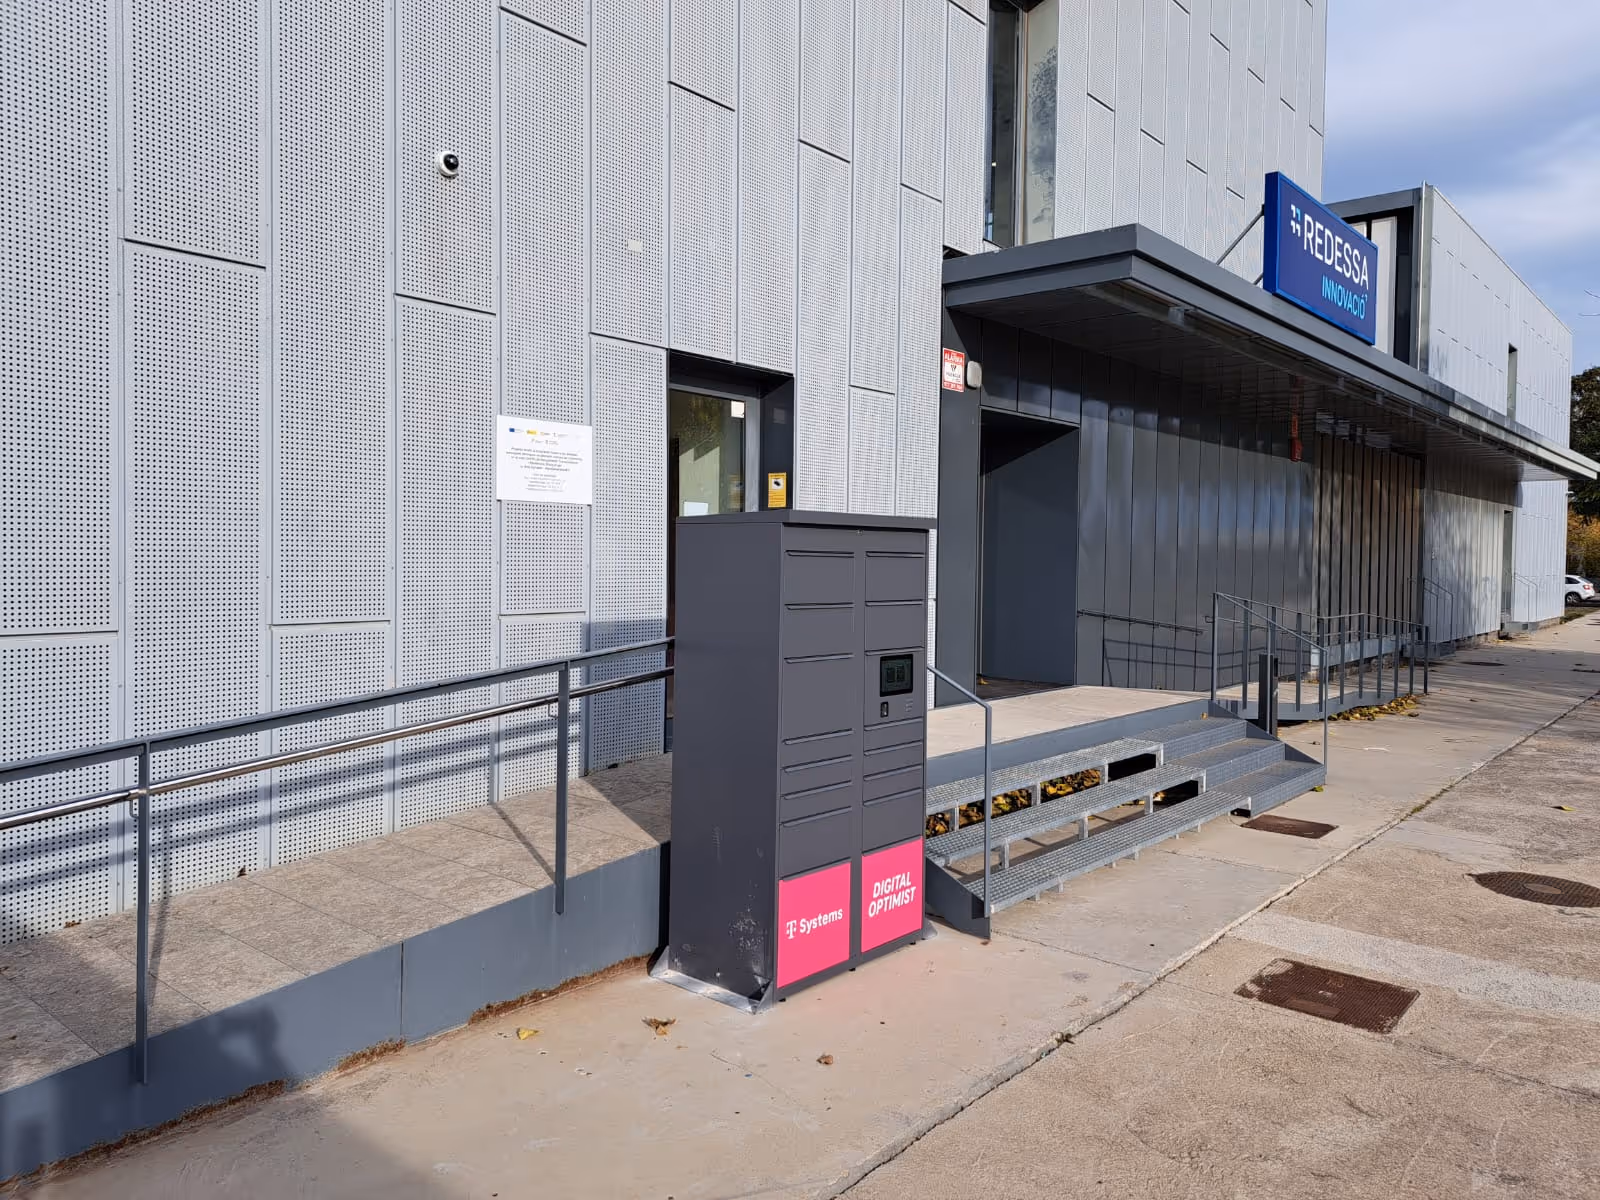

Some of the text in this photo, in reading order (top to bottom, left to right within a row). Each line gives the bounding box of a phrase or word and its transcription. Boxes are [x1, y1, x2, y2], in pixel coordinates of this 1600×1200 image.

[1304, 214, 1368, 290] REDESSA
[1322, 275, 1366, 320] INNOVACIÓ
[873, 872, 911, 898] DIGITAL
[868, 886, 916, 918] OPTIMIST
[800, 908, 843, 935] Systems
